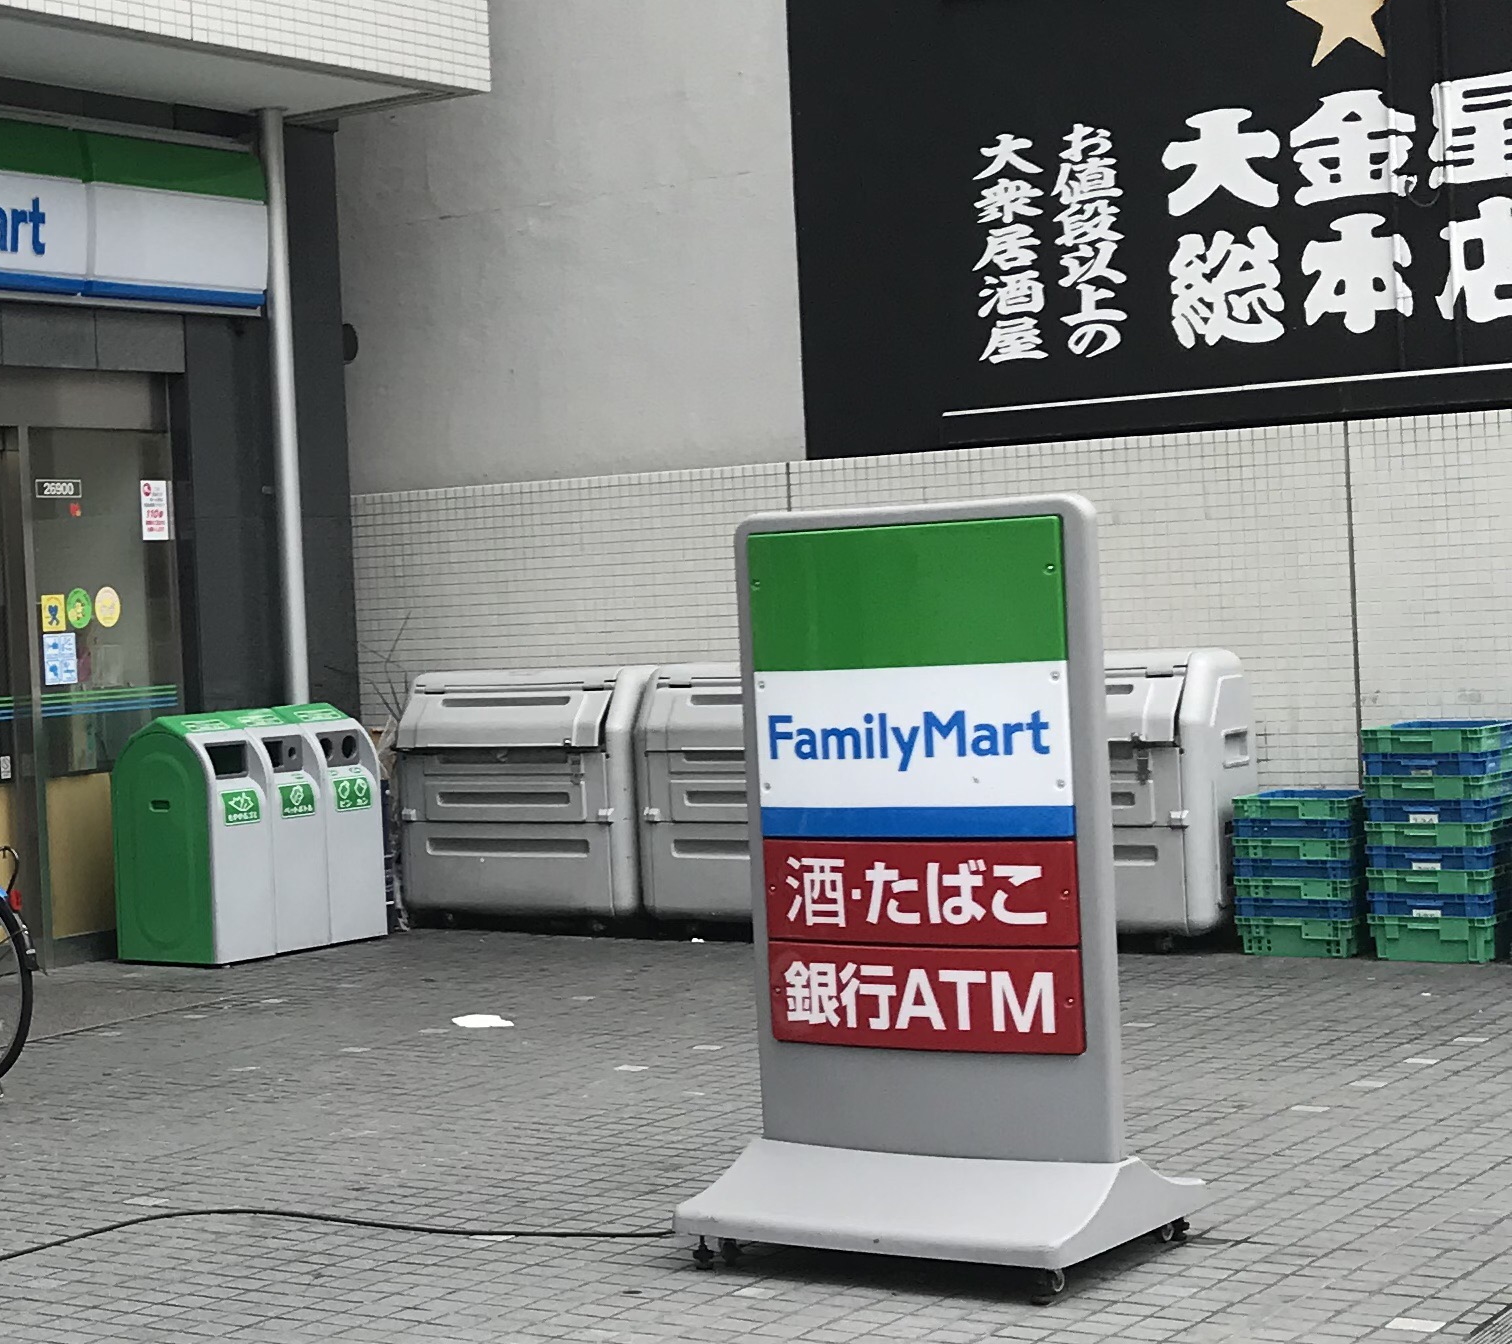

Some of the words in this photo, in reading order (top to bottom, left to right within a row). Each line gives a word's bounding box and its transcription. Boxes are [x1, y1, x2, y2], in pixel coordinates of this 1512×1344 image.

[973, 133, 1049, 364] 大衆居酒屋
[1051, 122, 1128, 358] お値段以上の
[43, 482, 75, 495] 26900
[767, 709, 1052, 772] FamilyMart
[783, 959, 1058, 1035] 銀行ATM
